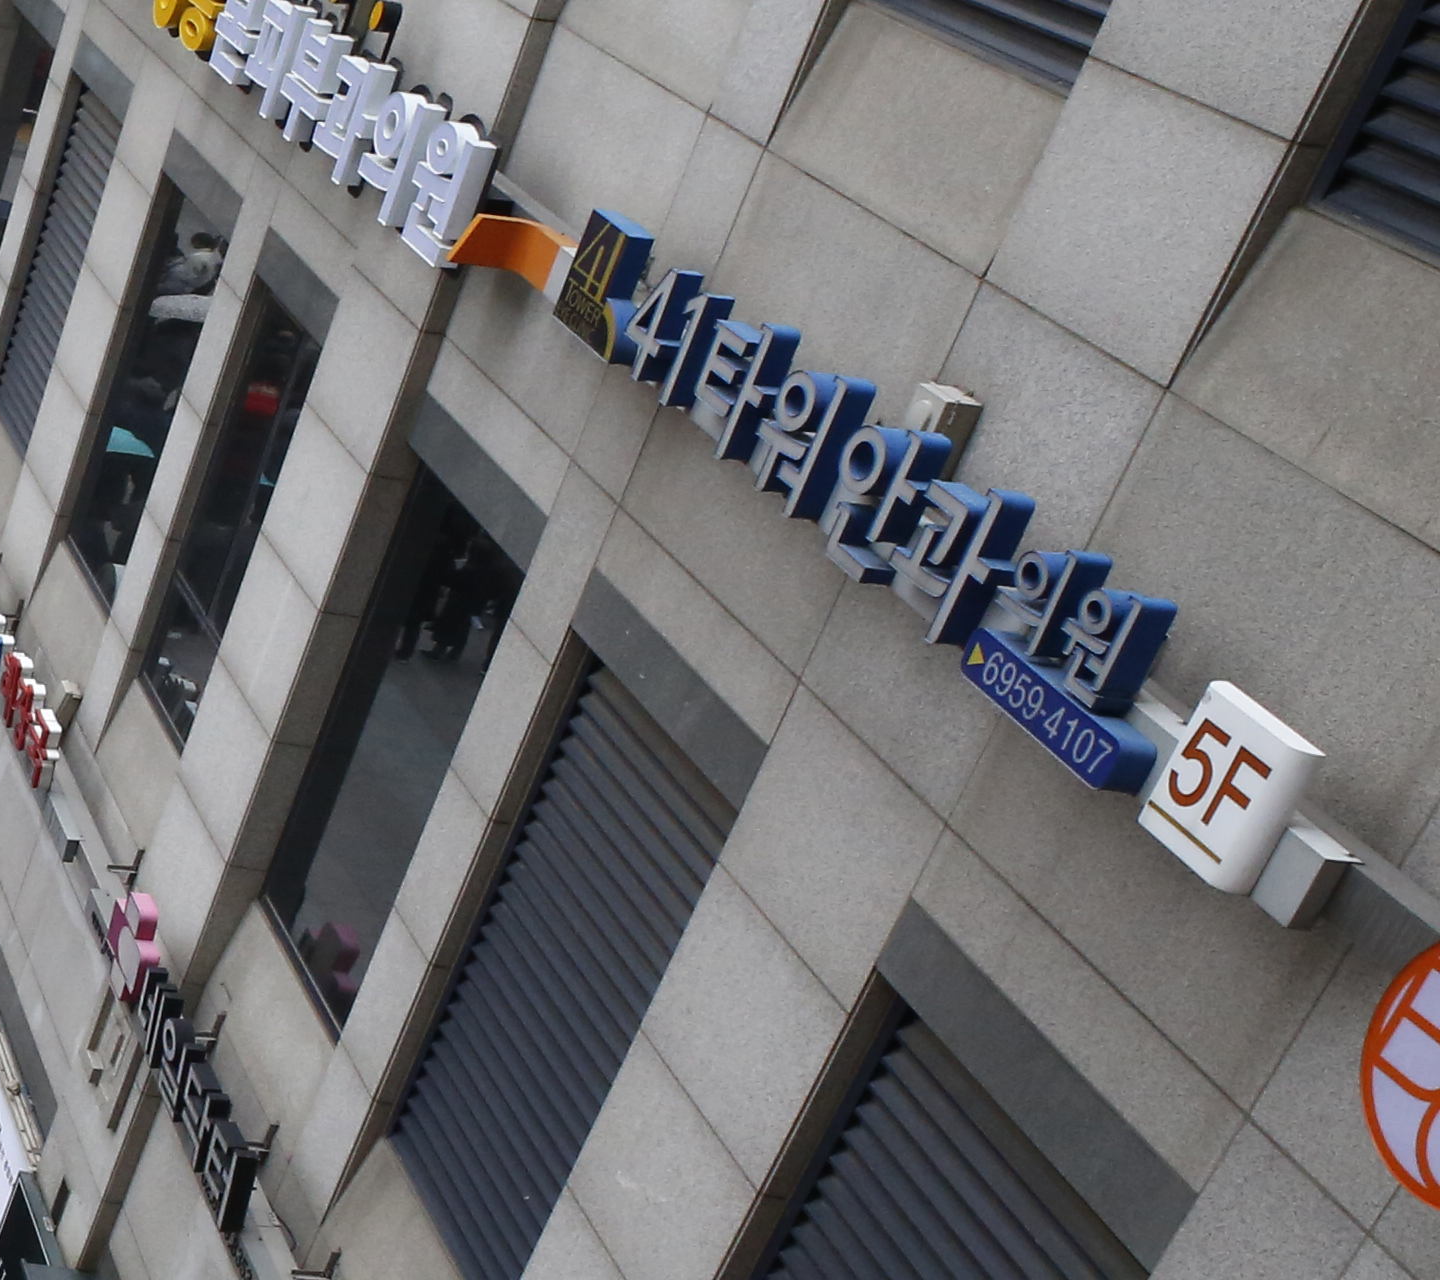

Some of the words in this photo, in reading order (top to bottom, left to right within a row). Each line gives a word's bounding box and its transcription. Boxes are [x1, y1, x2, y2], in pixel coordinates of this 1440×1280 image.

[569, 278, 603, 327] TOWER
[980, 647, 1115, 778] 6959-4107
[1167, 717, 1273, 830] 5F
